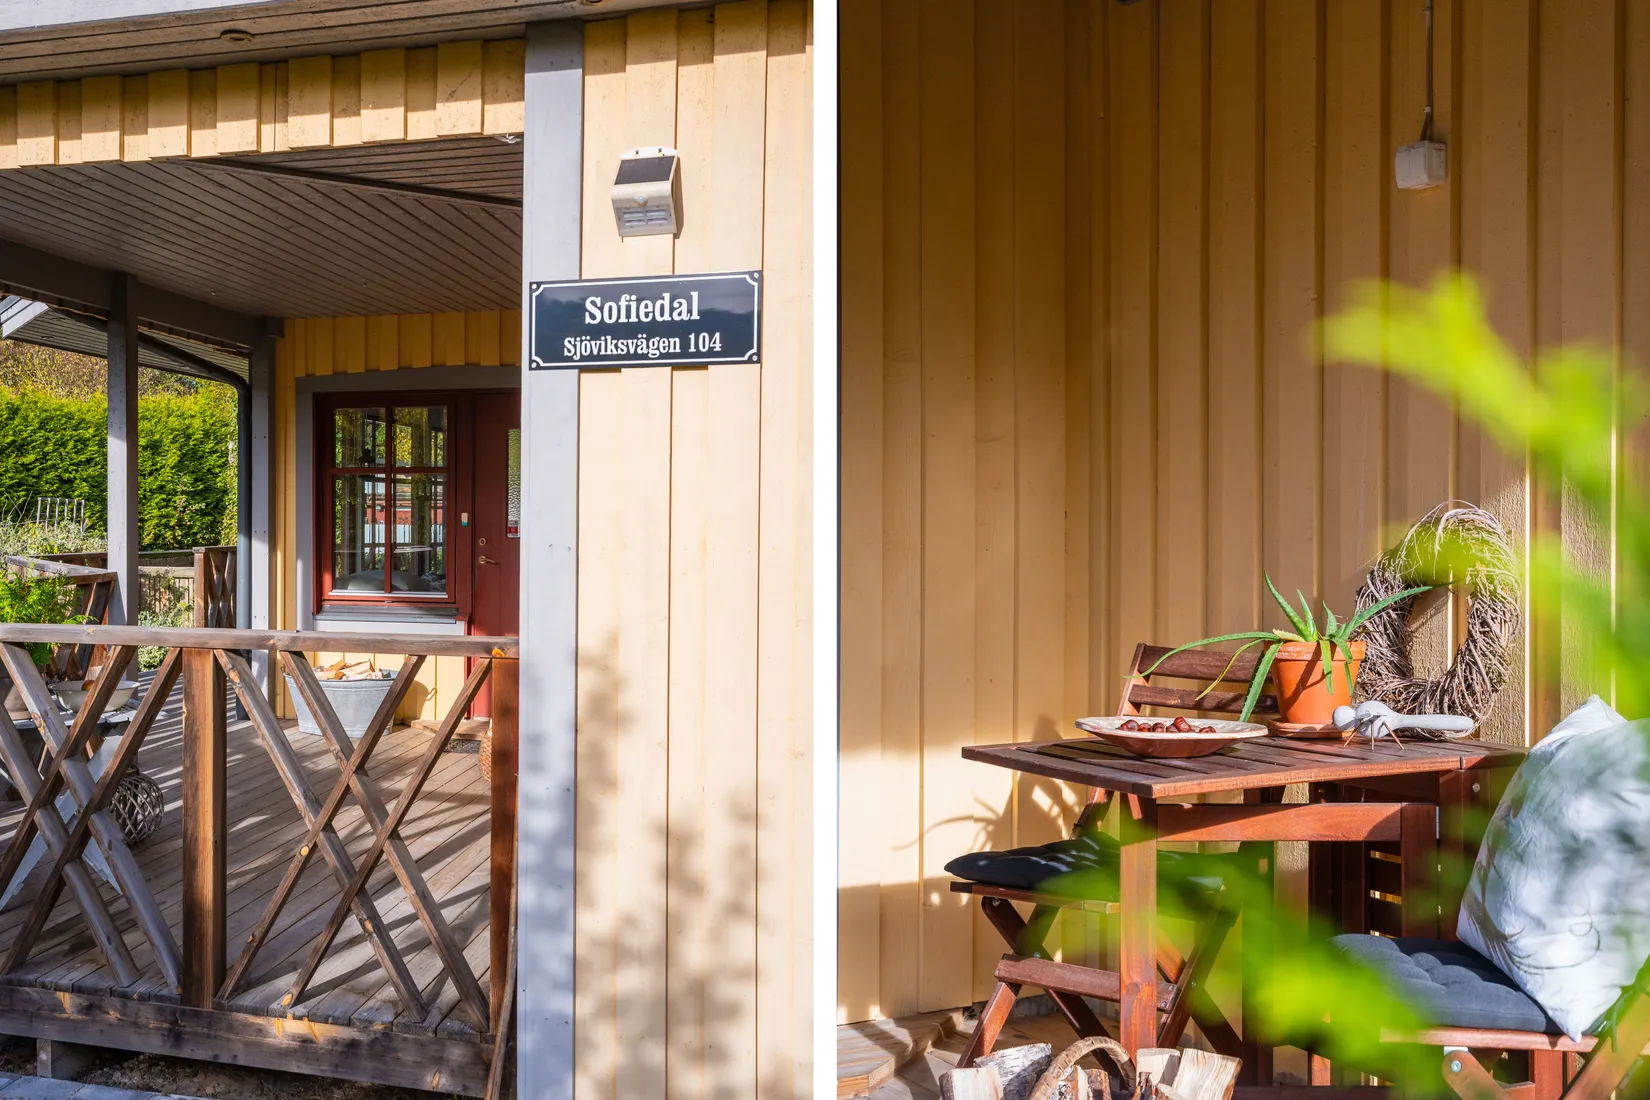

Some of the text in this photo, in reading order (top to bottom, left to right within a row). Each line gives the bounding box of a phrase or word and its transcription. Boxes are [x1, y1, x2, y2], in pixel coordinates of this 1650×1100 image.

[585, 291, 700, 324] Sofiedal
[563, 332, 722, 360] Sjöviksvägen 104
